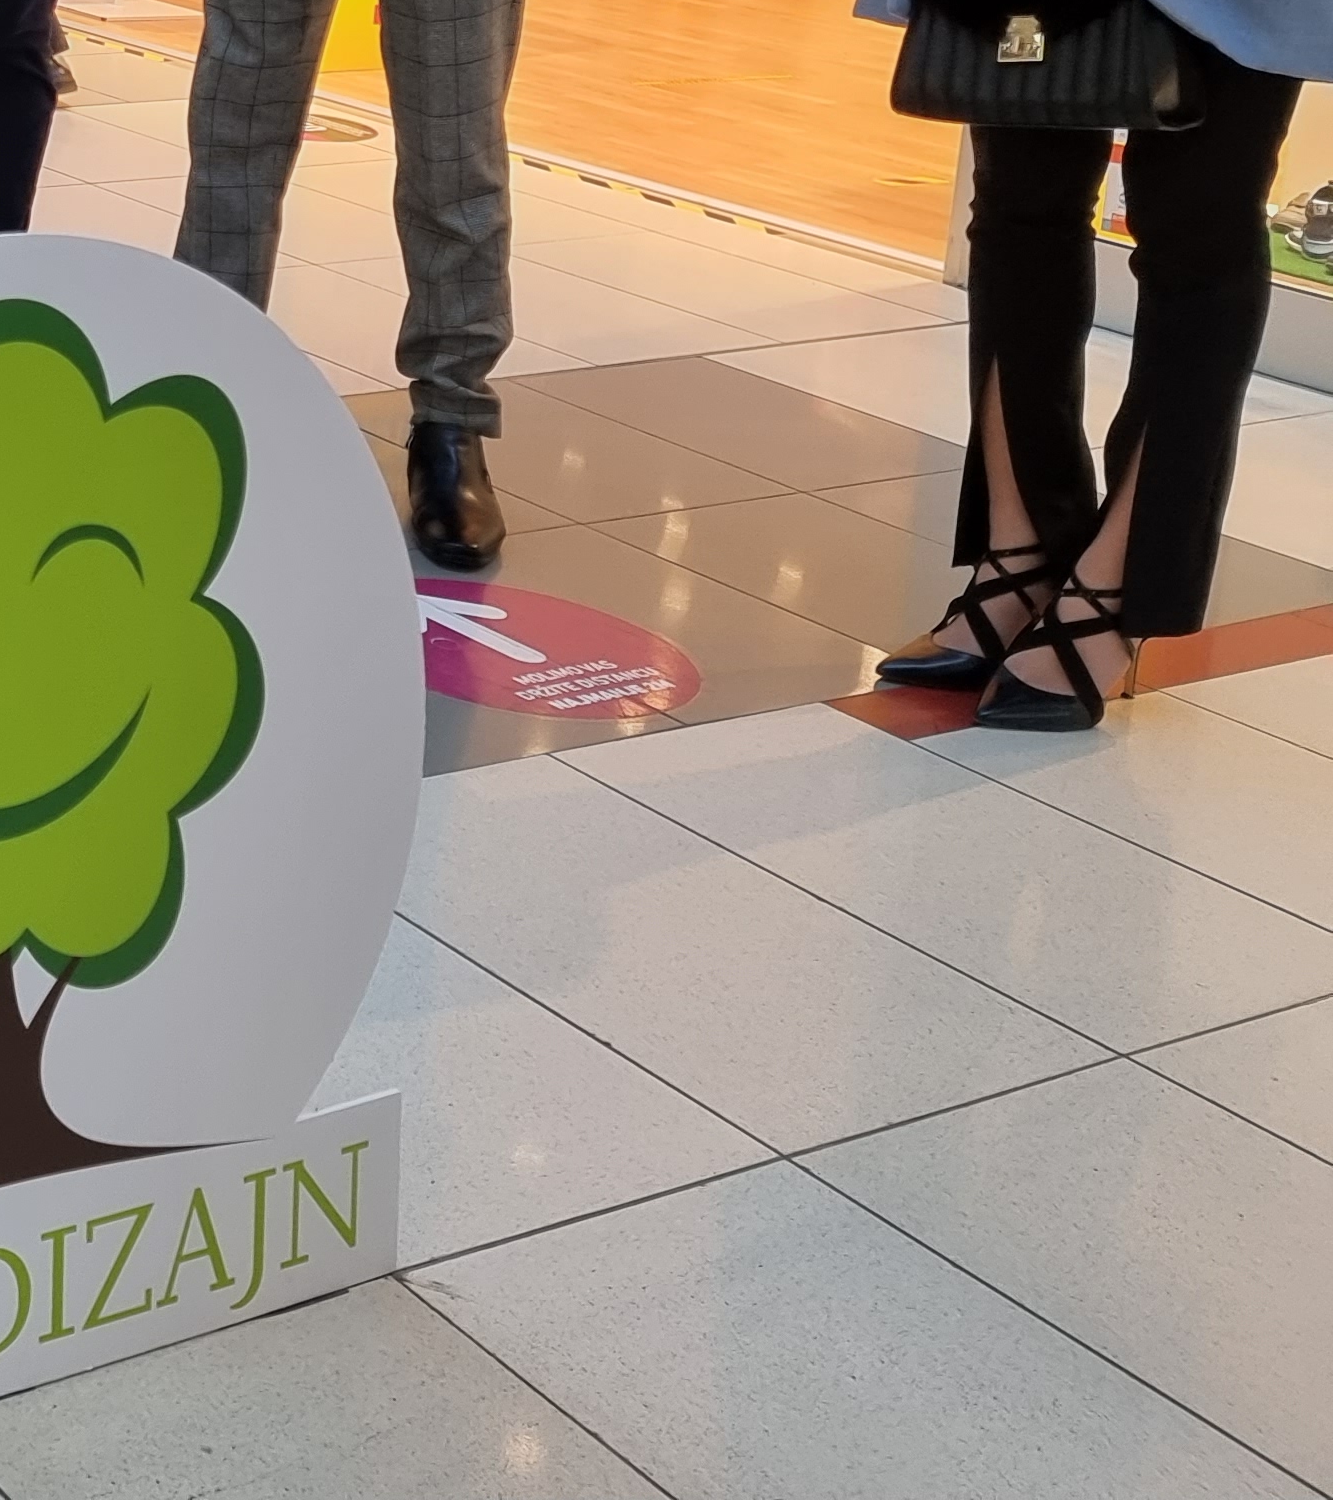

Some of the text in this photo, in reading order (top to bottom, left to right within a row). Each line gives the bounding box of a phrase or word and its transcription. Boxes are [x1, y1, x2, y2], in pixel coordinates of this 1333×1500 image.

[512, 659, 619, 686] MOLIMO VAS
[513, 666, 663, 702] DRŽITE DISTANCU
[547, 683, 650, 711] NAJMANJE
